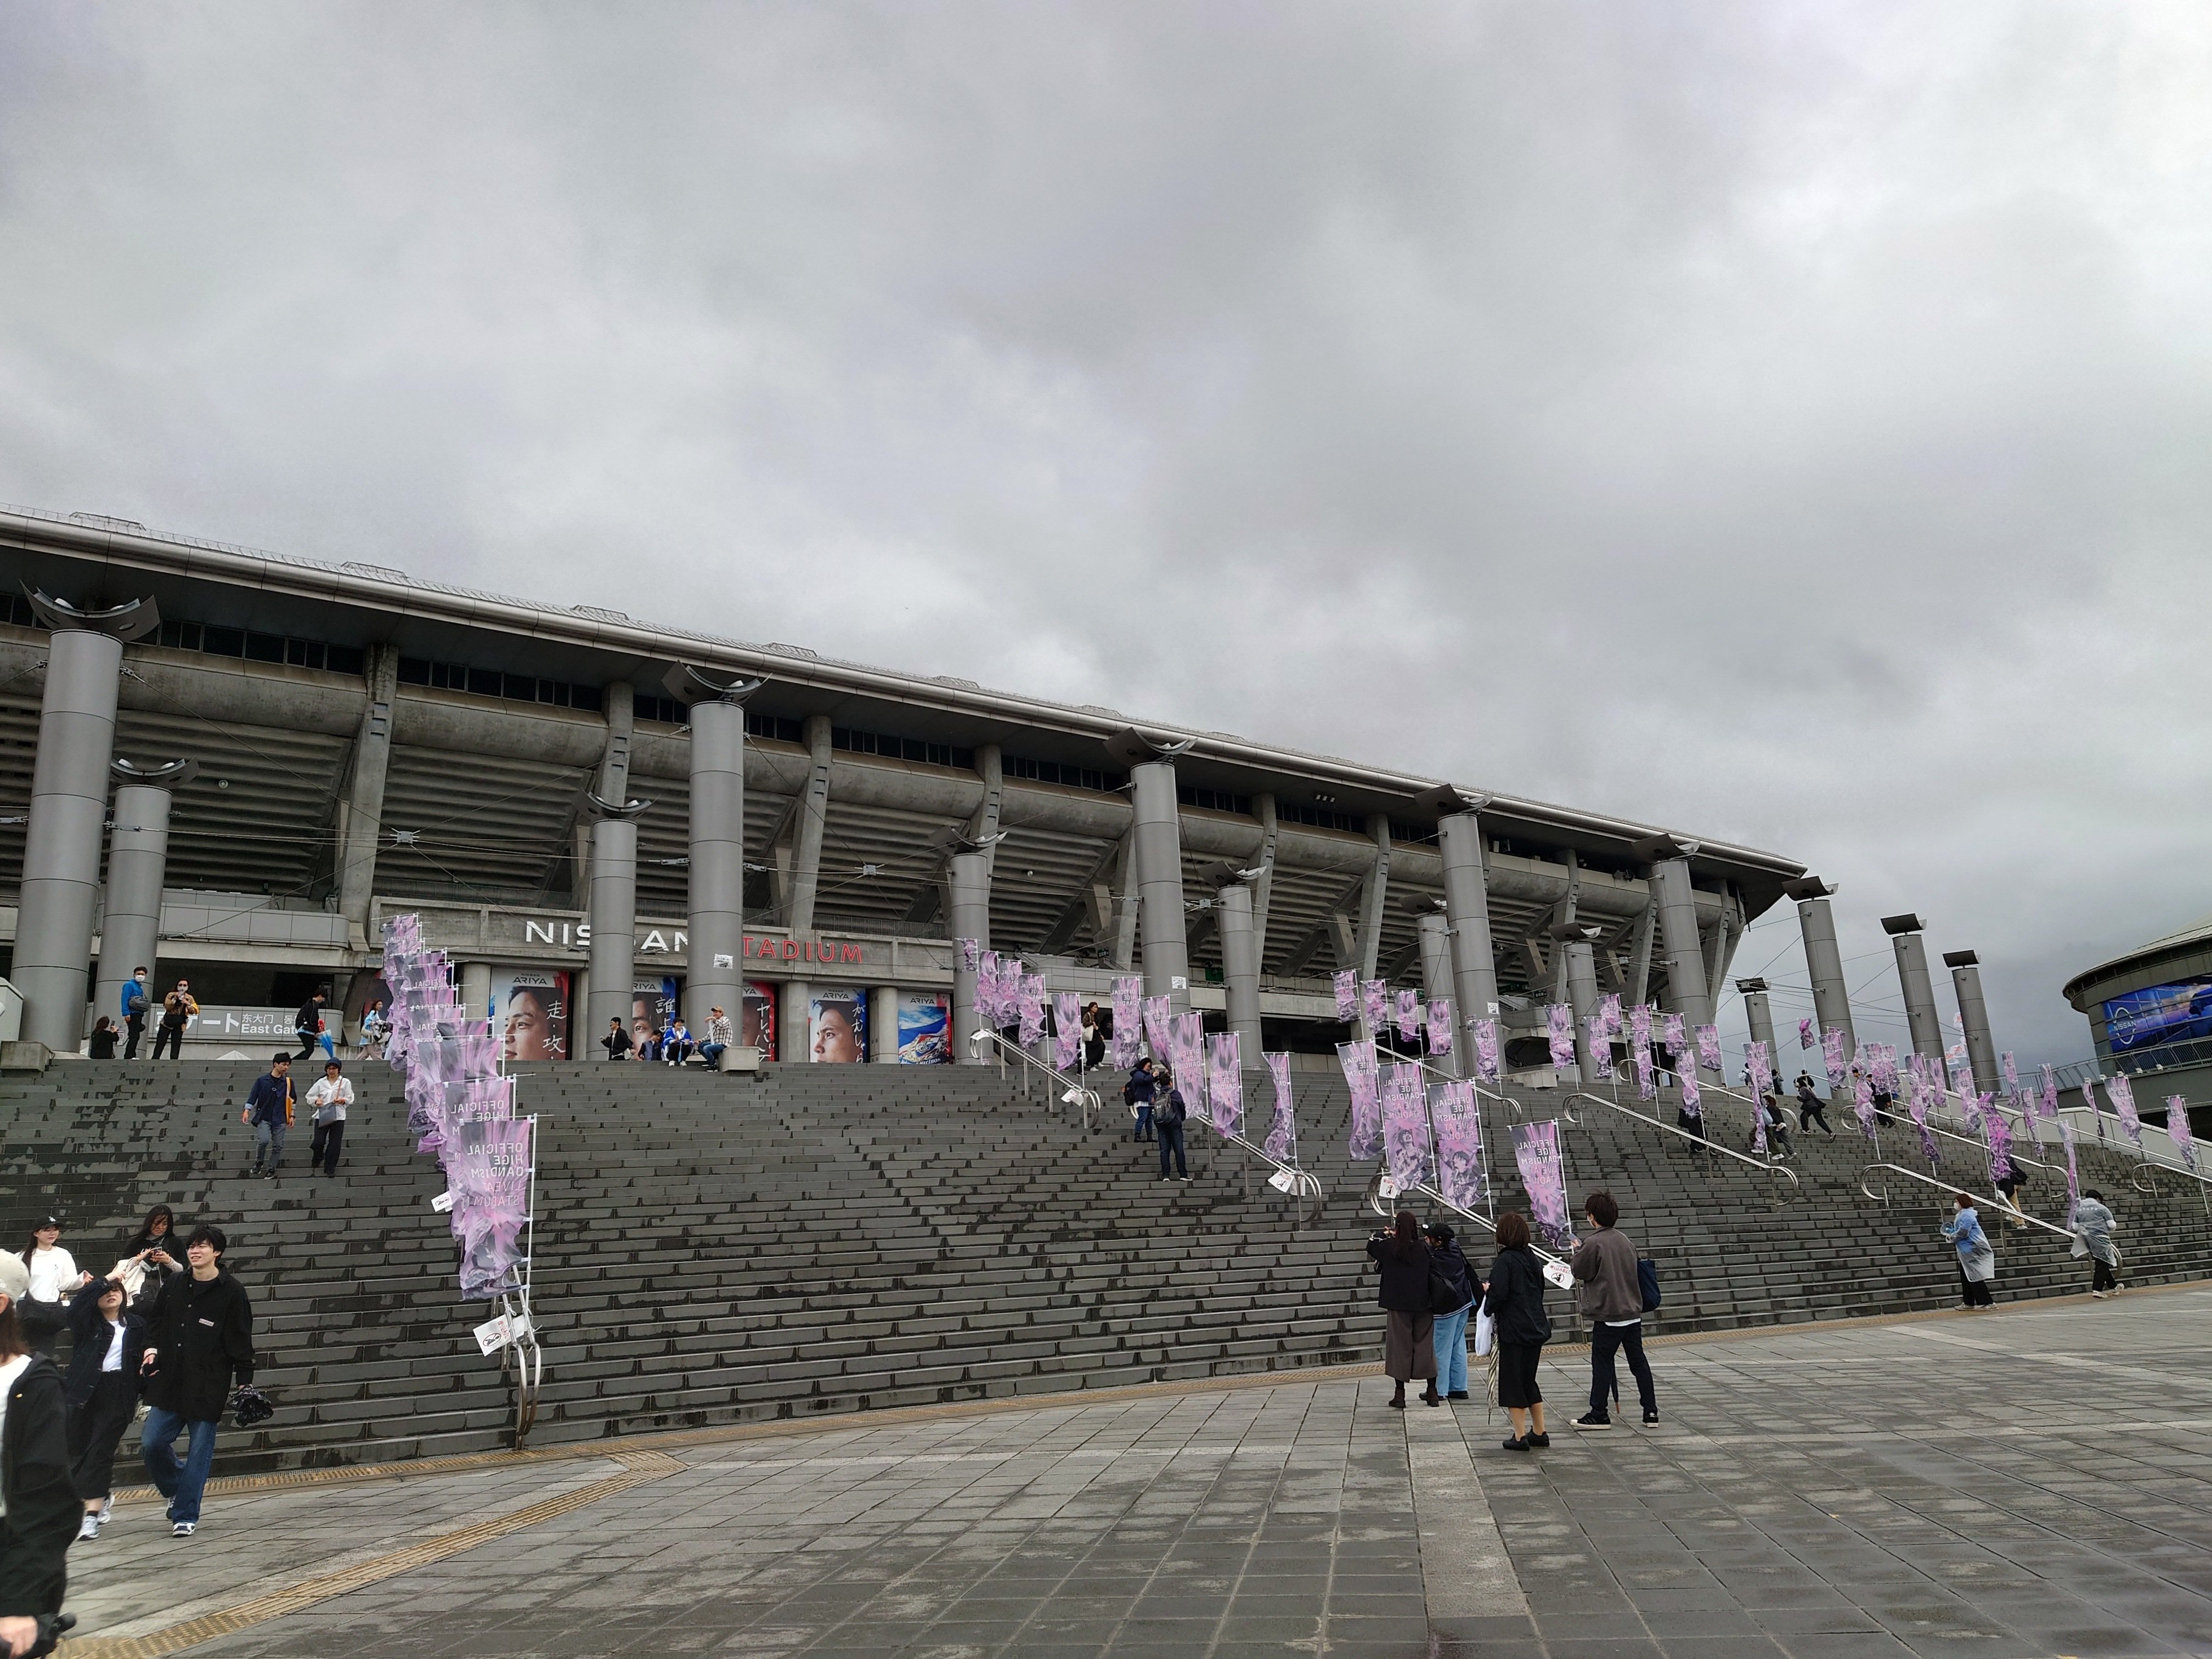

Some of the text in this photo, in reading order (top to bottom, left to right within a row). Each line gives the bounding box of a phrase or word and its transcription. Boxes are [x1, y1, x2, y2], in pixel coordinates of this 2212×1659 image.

[526, 921, 688, 952] NISAN
[743, 936, 862, 963] TADIUM
[512, 977, 548, 985] ARIYA
[242, 1014, 274, 1024] 东大门
[241, 1024, 269, 1034] East
[2114, 1020, 2136, 1031] NISSAN
